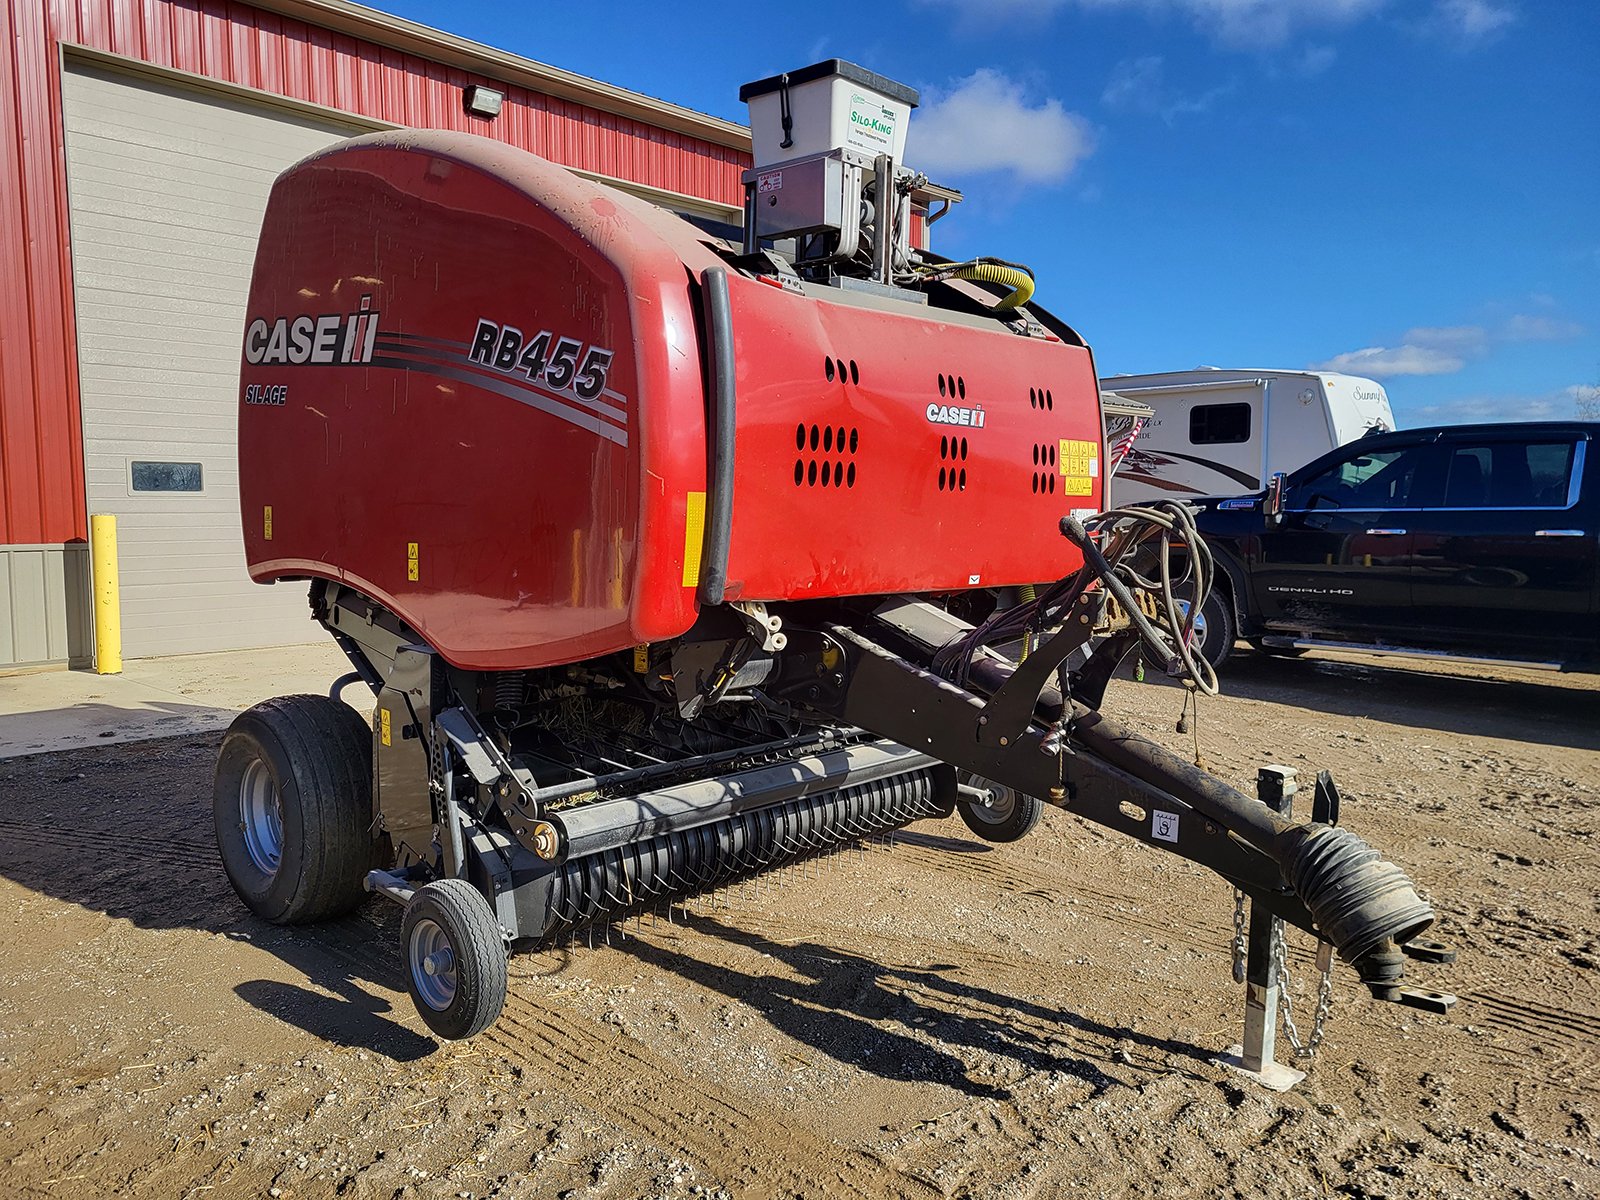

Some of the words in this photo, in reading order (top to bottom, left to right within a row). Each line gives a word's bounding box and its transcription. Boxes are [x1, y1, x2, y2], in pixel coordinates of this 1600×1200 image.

[851, 111, 892, 135] SILO-KING
[760, 173, 781, 181] CAUTION
[246, 316, 340, 364] CASE
[468, 317, 614, 403] RB455
[245, 384, 287, 407] SILAGE
[926, 403, 970, 426] CASE
[1268, 586, 1327, 594] DENALI
